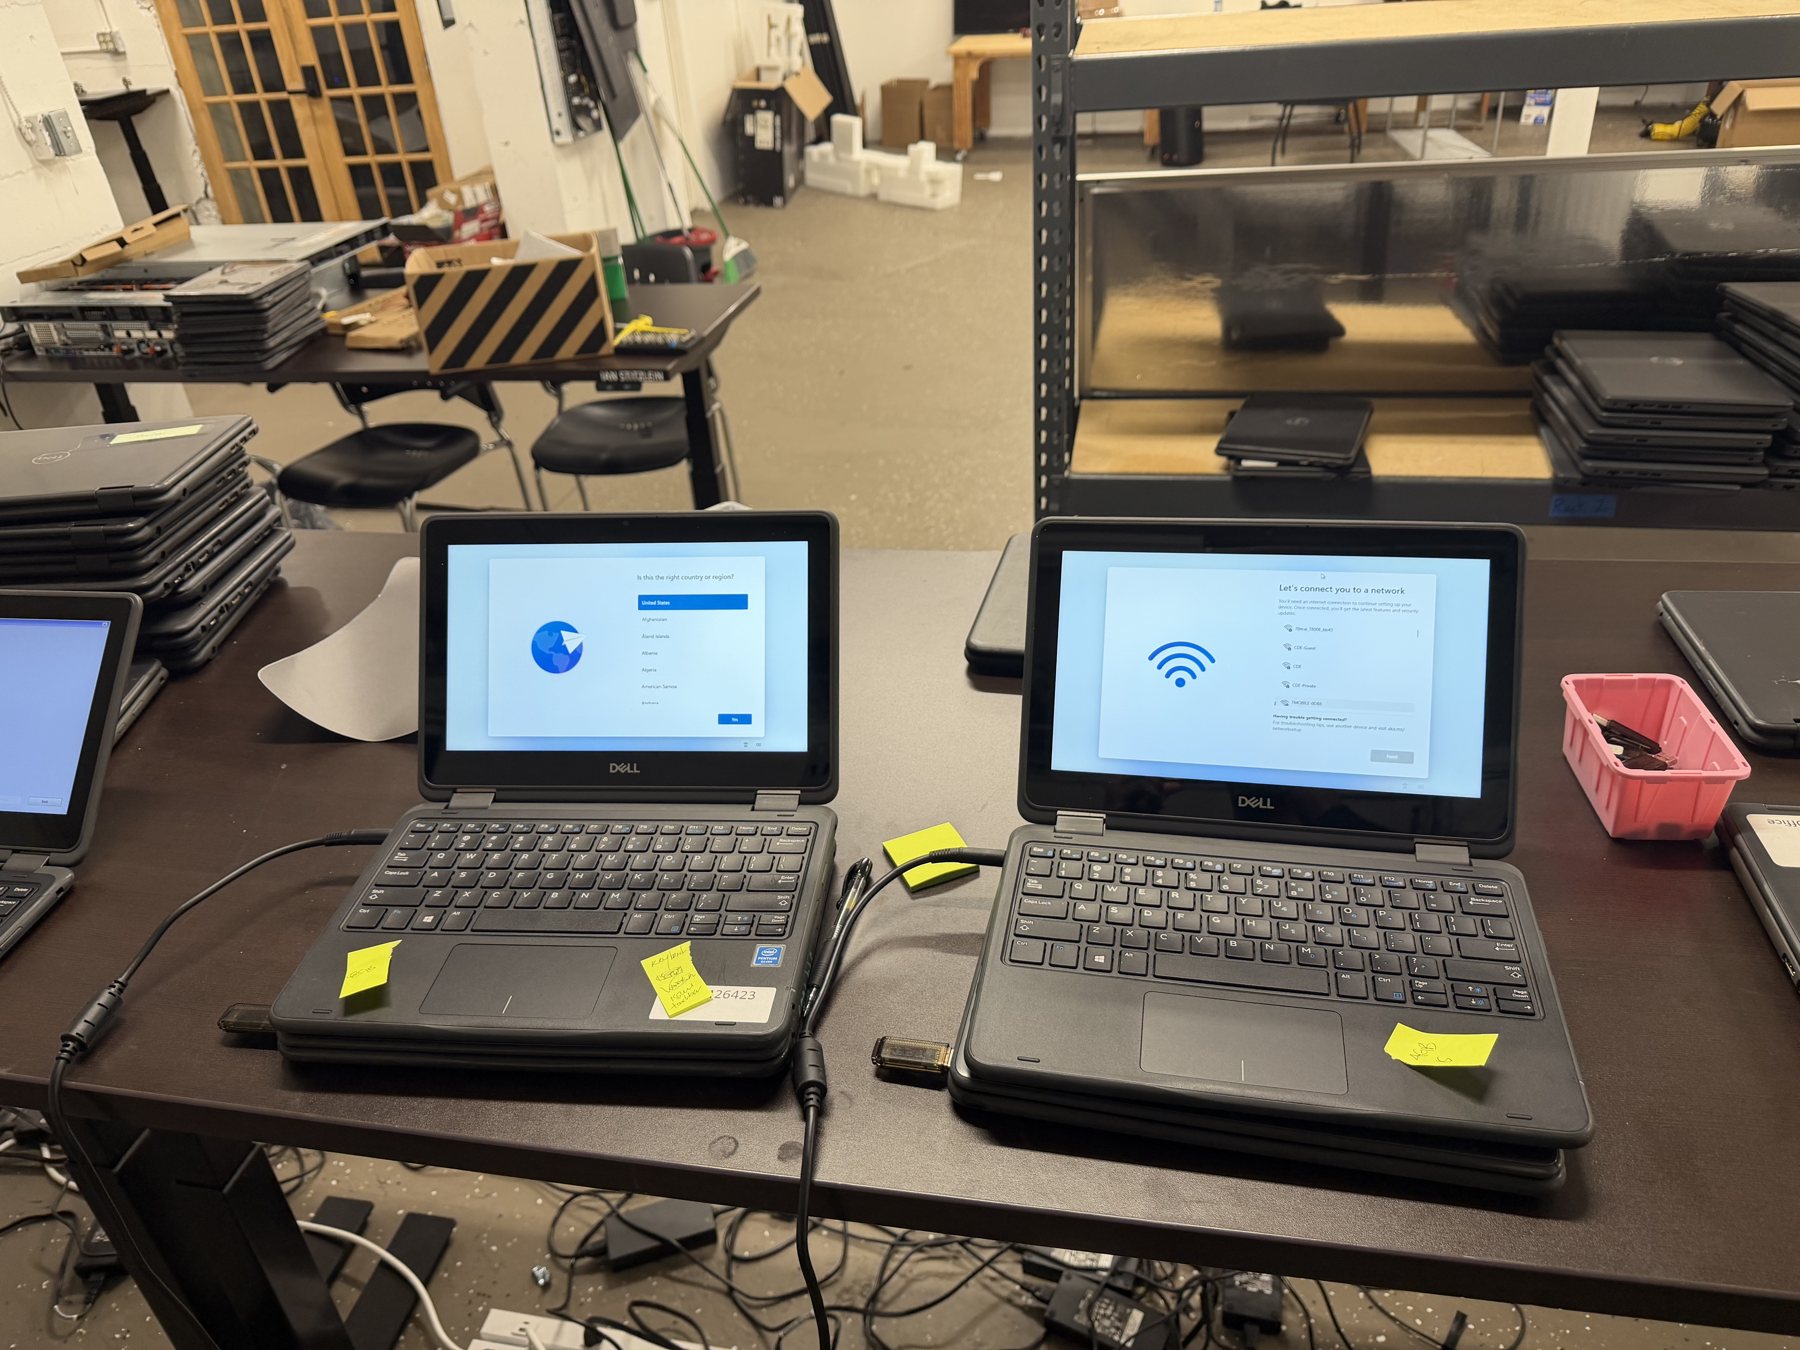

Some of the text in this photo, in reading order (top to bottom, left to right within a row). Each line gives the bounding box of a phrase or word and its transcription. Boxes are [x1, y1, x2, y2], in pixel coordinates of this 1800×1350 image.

[666, 574, 680, 582] right
[712, 574, 734, 582] region?
[609, 762, 640, 773] DELL
[1238, 796, 1275, 809] DELL
[711, 990, 756, 1000] 26423
